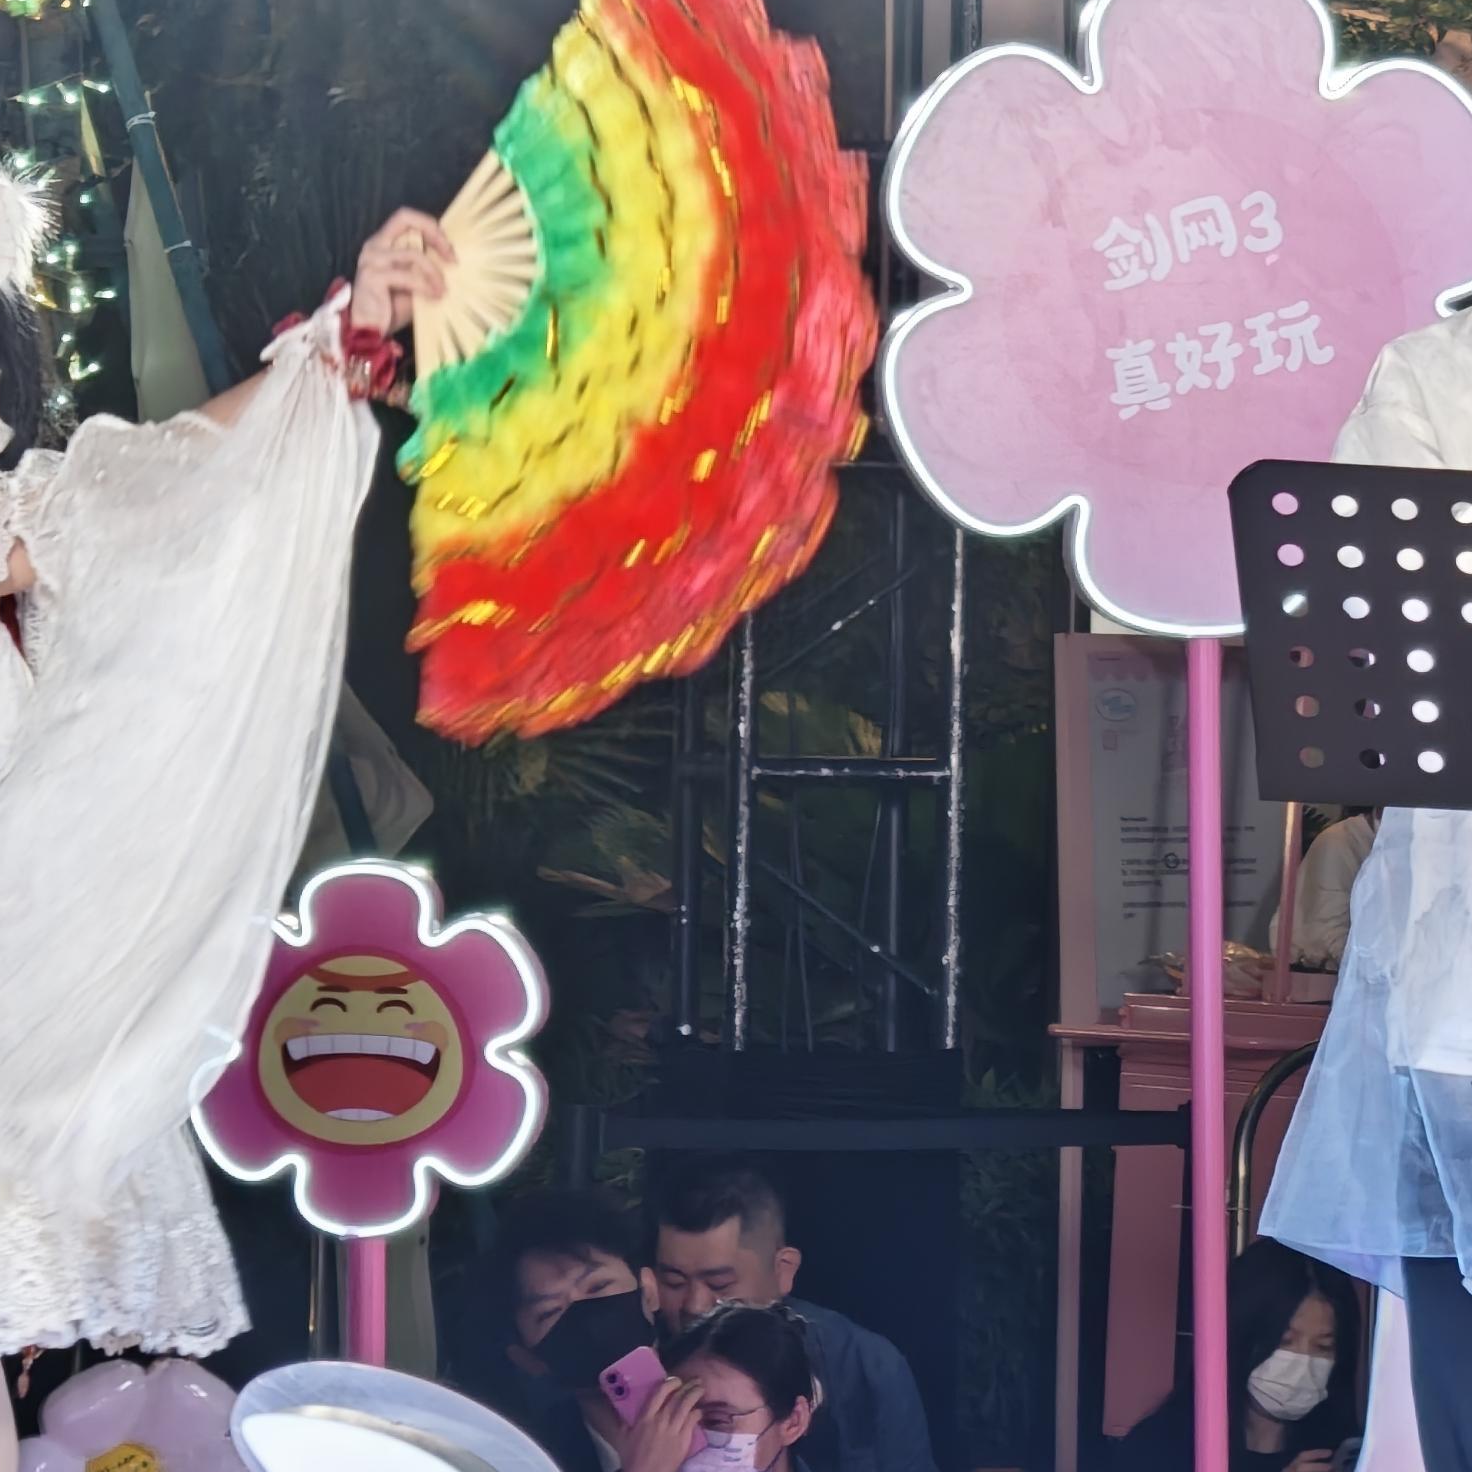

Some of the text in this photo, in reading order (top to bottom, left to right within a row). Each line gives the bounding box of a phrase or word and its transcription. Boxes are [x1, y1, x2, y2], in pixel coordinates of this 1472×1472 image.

[1092, 189, 1284, 292] 剑网3
[1105, 299, 1335, 421] 真好玩
